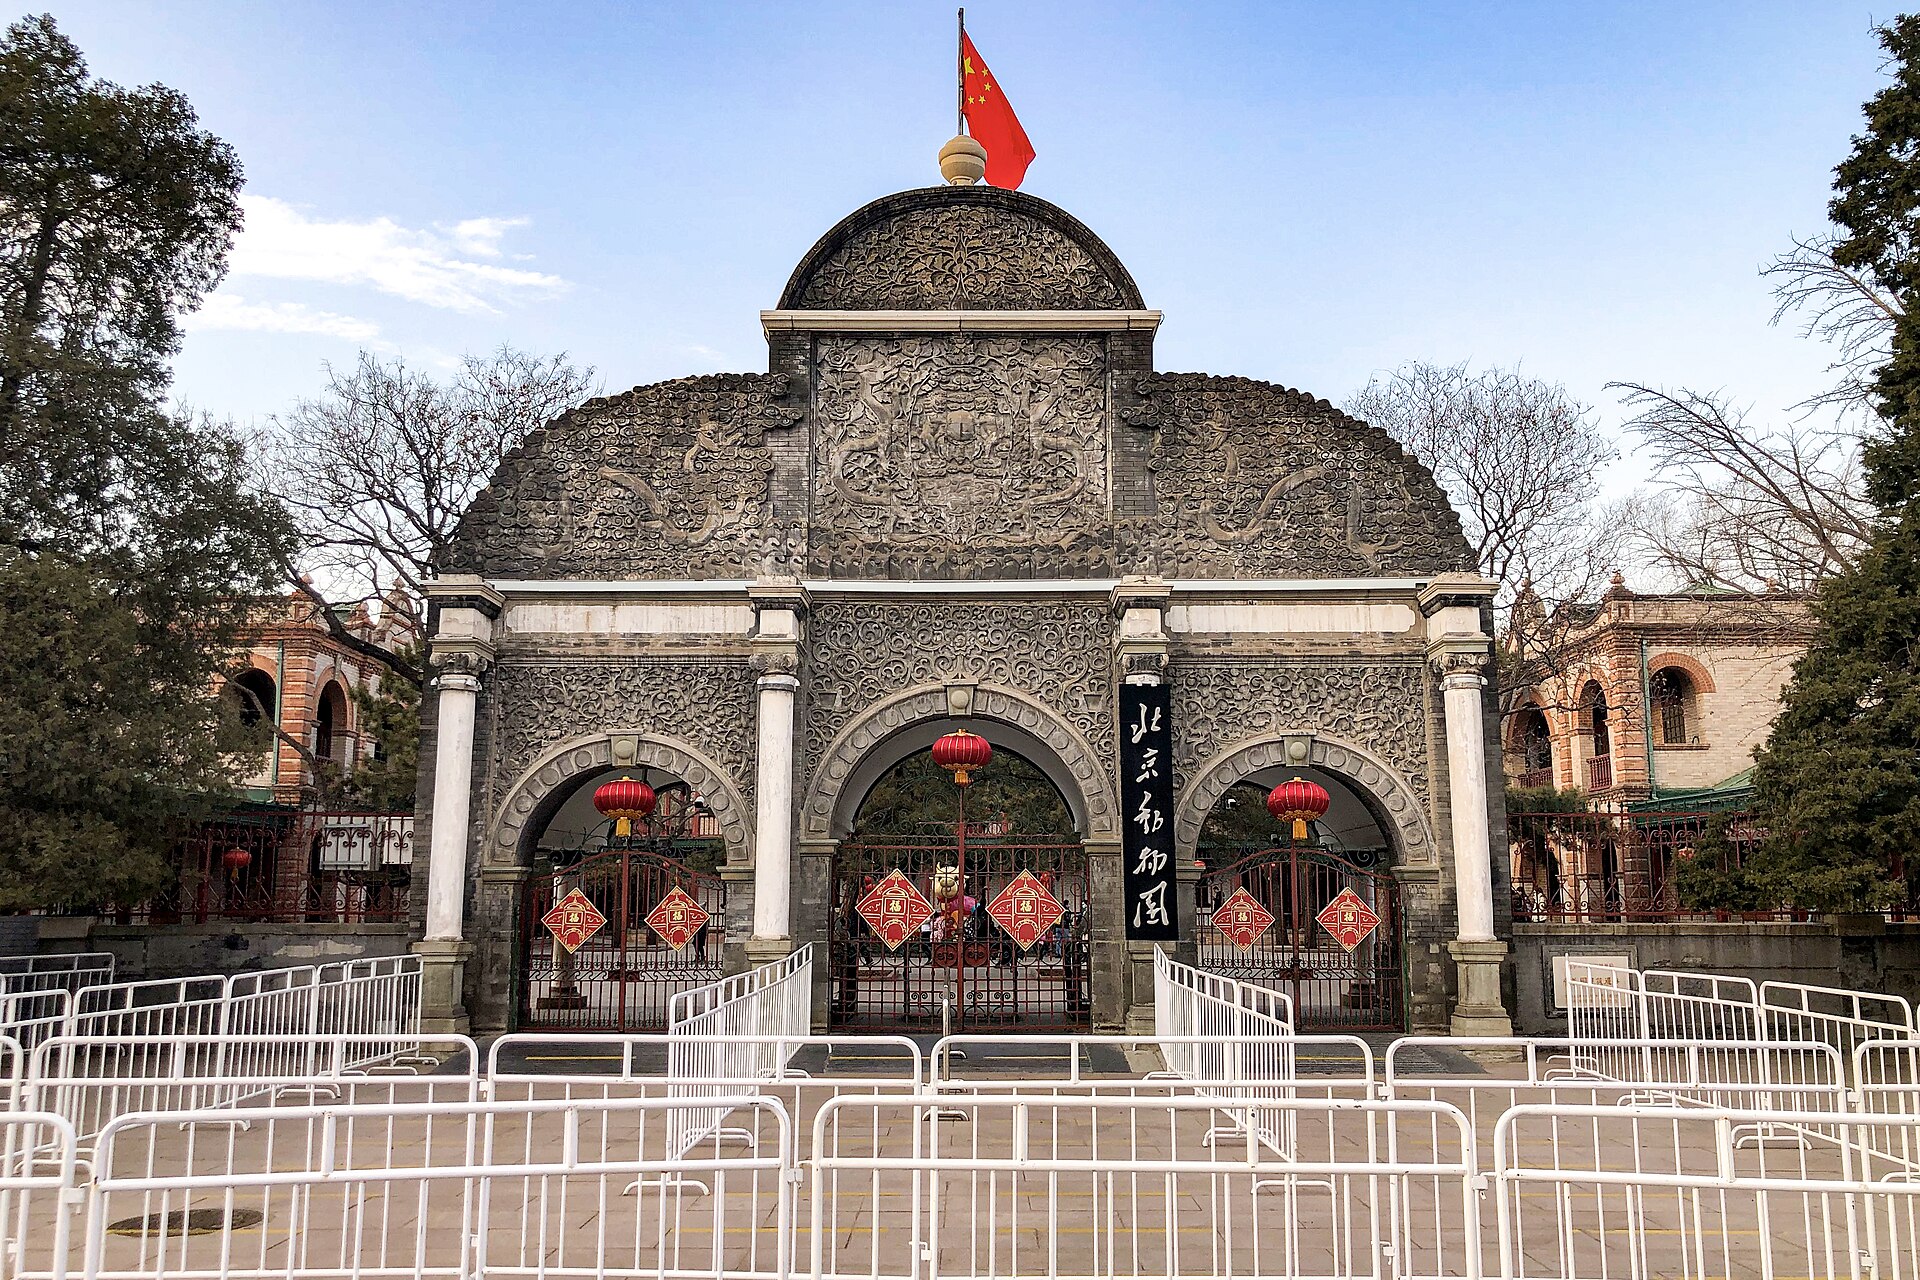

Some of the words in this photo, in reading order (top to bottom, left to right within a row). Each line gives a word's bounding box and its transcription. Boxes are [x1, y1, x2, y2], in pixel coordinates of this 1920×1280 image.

[889, 899, 902, 913] 福
[1020, 899, 1033, 913] 福
[568, 912, 580, 923] 福
[673, 910, 683, 921] 福
[1237, 911, 1248, 922] 福
[1343, 911, 1355, 922] 福
